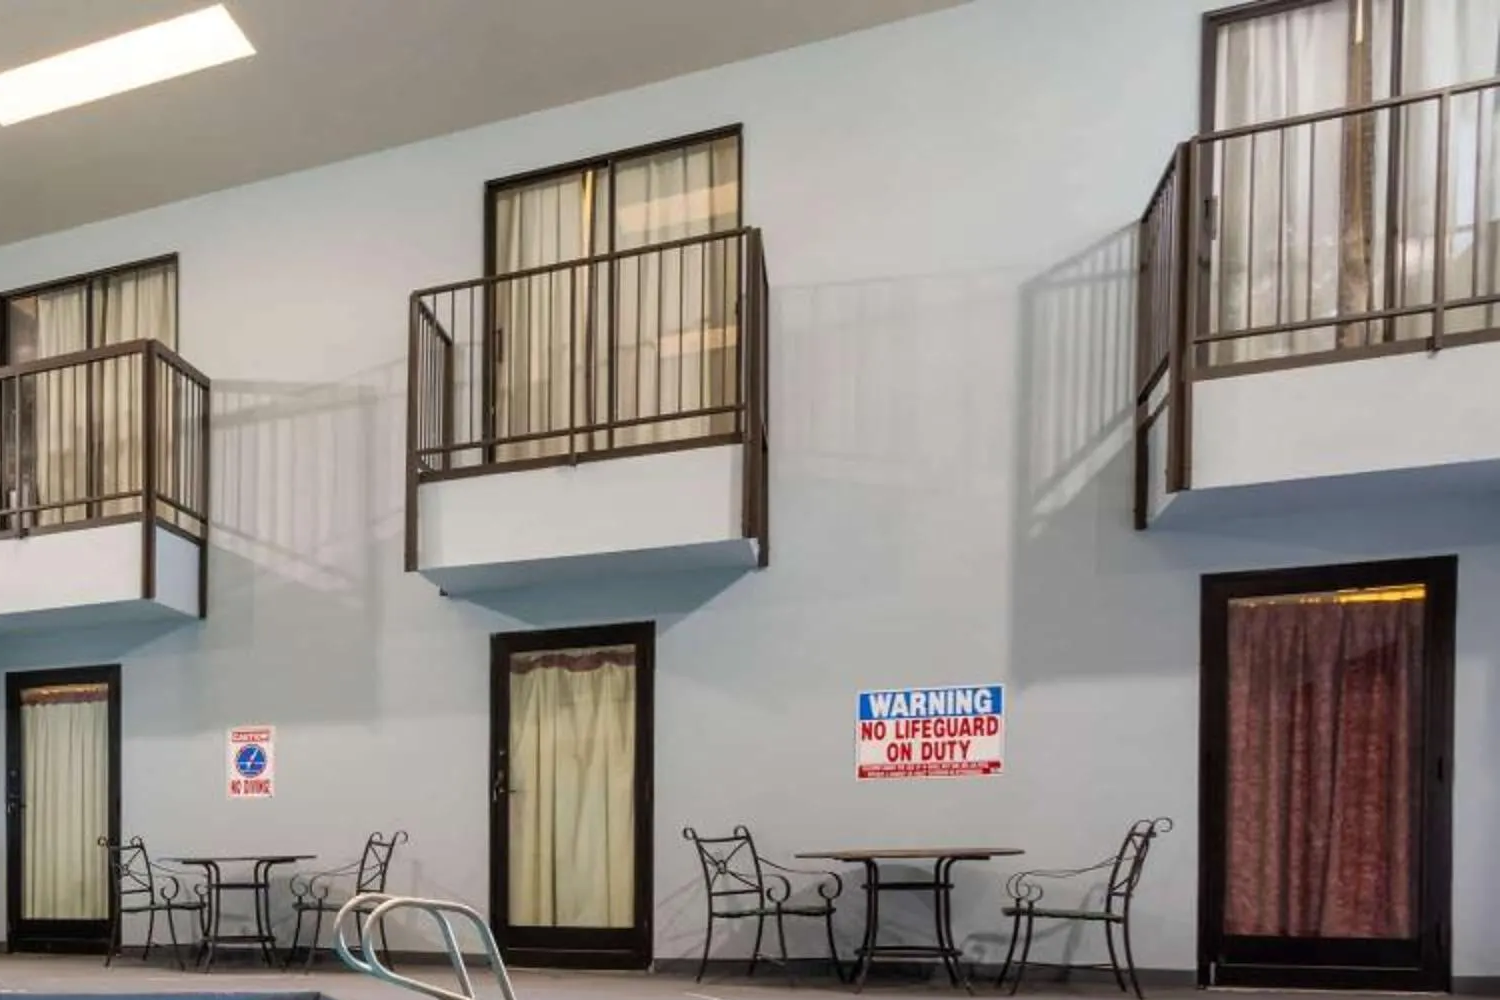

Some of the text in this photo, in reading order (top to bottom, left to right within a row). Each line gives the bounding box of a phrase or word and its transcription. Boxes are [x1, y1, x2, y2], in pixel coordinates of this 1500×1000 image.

[870, 689, 992, 717] WARNING
[861, 716, 999, 740] NO LIFEGUARD
[887, 740, 971, 762] ON DUTY
